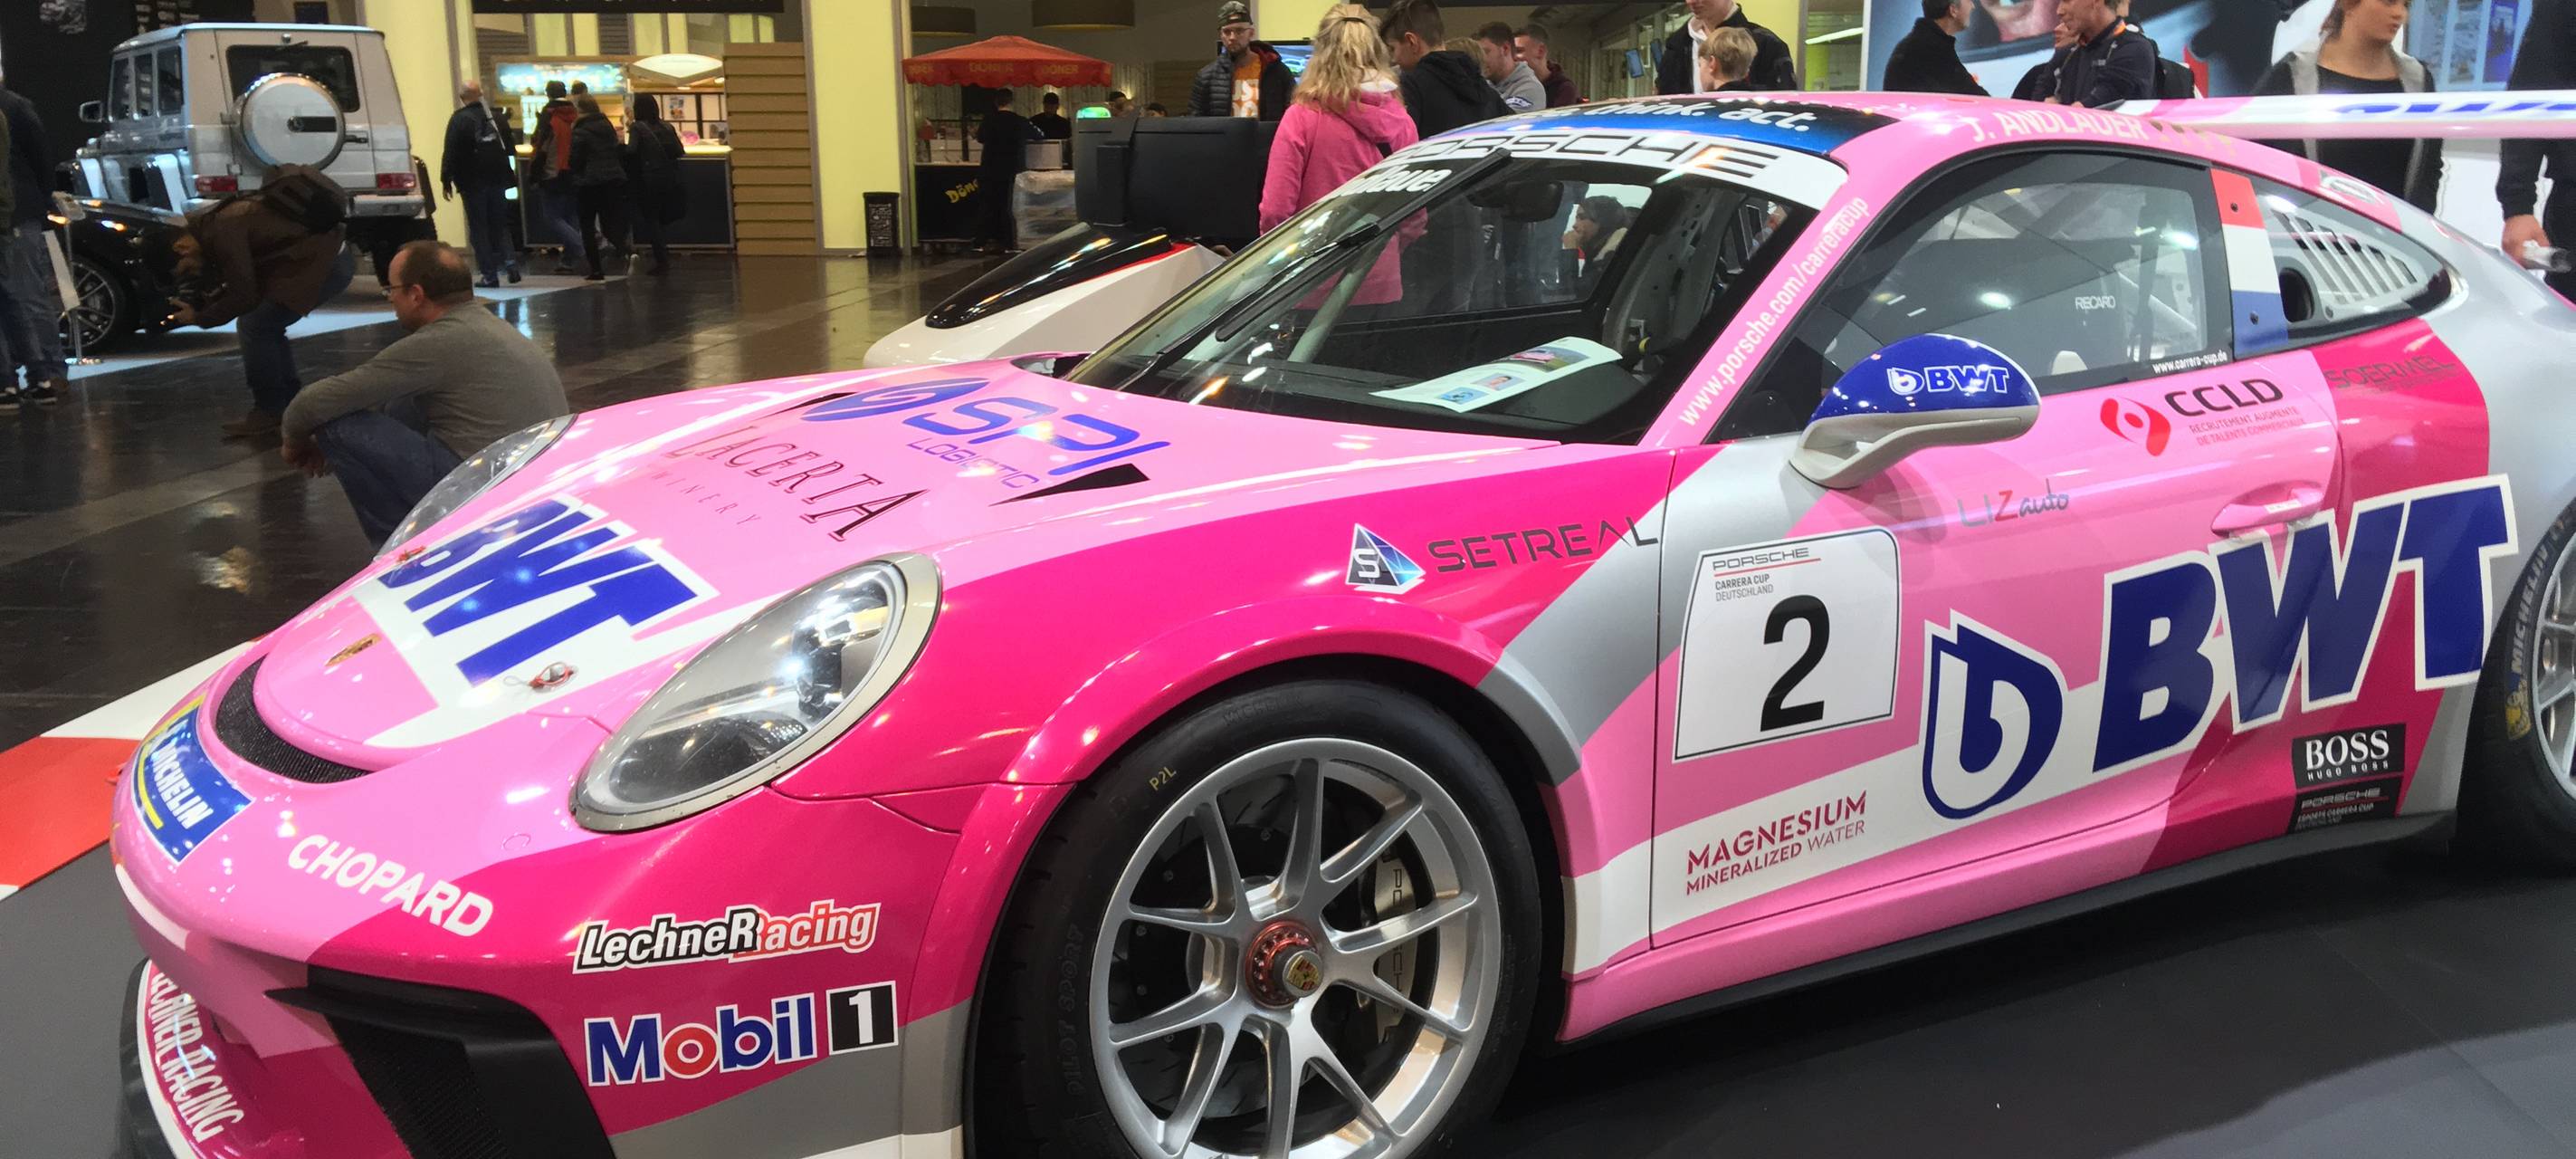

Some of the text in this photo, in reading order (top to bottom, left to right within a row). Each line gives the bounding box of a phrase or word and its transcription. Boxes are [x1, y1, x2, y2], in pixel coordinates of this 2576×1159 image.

[1993, 109, 2150, 140] ANDLAUER
[1678, 196, 1870, 426] www.porsche.com/carreracup
[2075, 295, 2116, 310] RECARO
[1923, 365, 2010, 394] BWT
[2151, 349, 2228, 375] www.carrera-cup.de
[2164, 378, 2285, 417] CCLD
[1426, 516, 1659, 573] SETREAL
[1713, 547, 1809, 571] PORSCHE
[376, 499, 698, 688] BWT
[1715, 573, 1771, 591] CARRERA CUP
[1716, 583, 1775, 602] DEUTSCHLAND
[2091, 484, 2509, 773] BWT
[1759, 594, 1830, 733] 2
[2305, 729, 2390, 771] BOSS
[2306, 767, 2342, 782] HUGO
[150, 737, 215, 830] MICHELIN
[1149, 767, 1177, 791] P2L
[1686, 819, 1865, 896] MINERALIZED WATER
[1687, 790, 1867, 876] MAGNESIUM
[287, 834, 494, 937] CHOPARD
[587, 995, 815, 1085] Mobil
[161, 1046, 244, 1144] RACING
